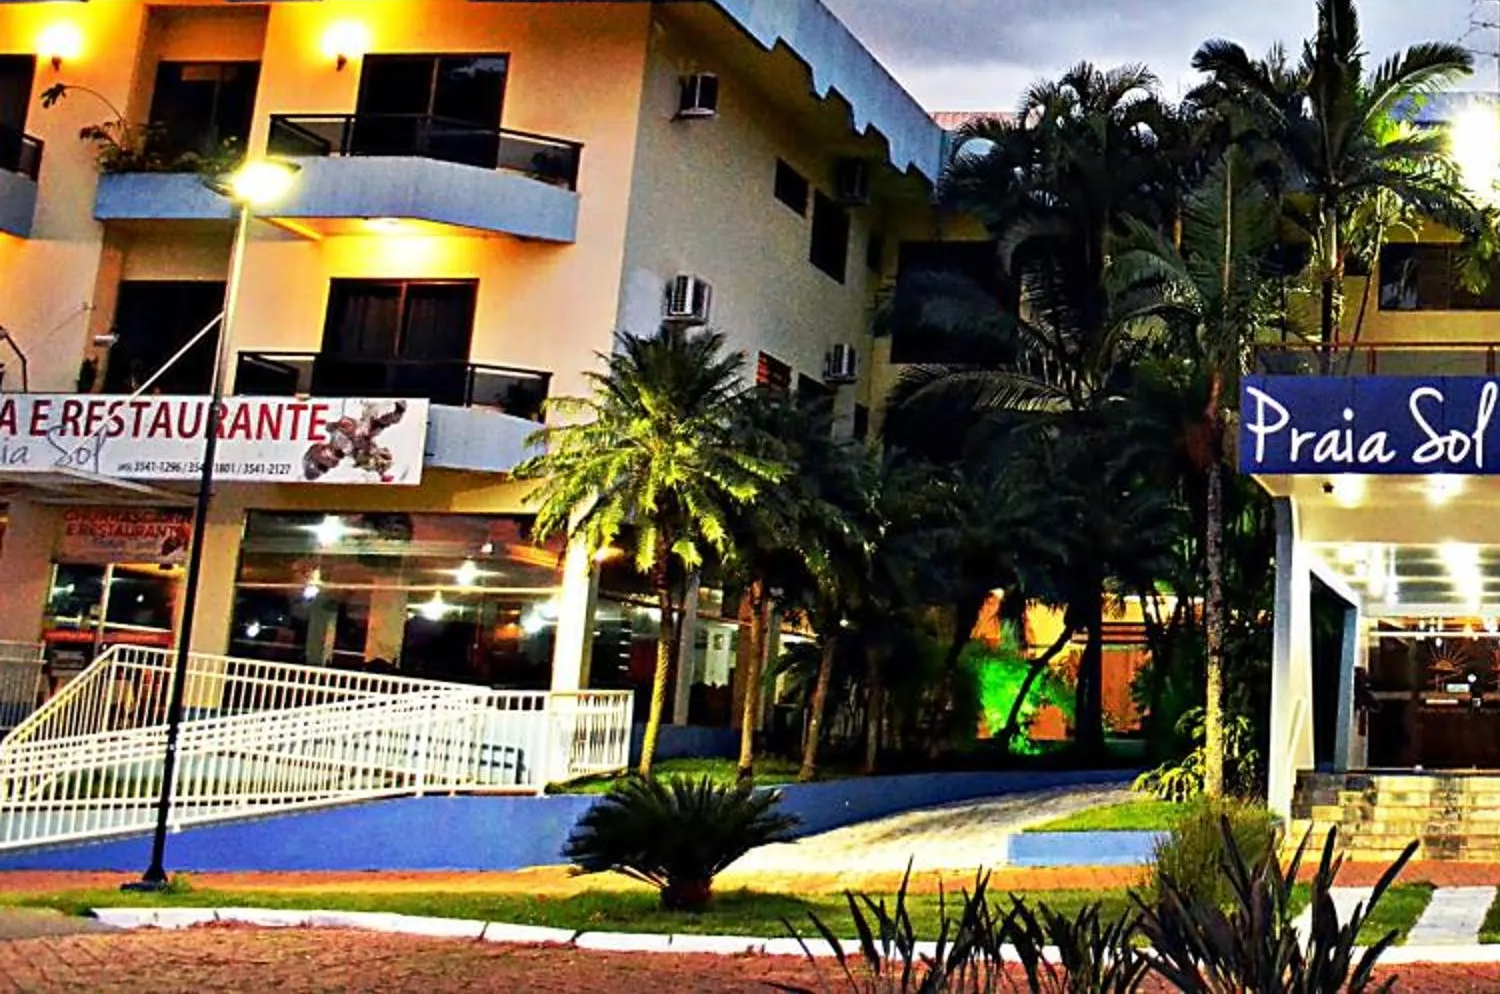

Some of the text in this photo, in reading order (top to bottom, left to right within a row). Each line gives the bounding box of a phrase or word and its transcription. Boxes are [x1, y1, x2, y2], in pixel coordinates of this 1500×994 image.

[29, 399, 51, 437] E
[59, 399, 329, 441] RESTAURANTE
[1245, 381, 1498, 469] Praia Sol
[47, 424, 109, 474] Sol
